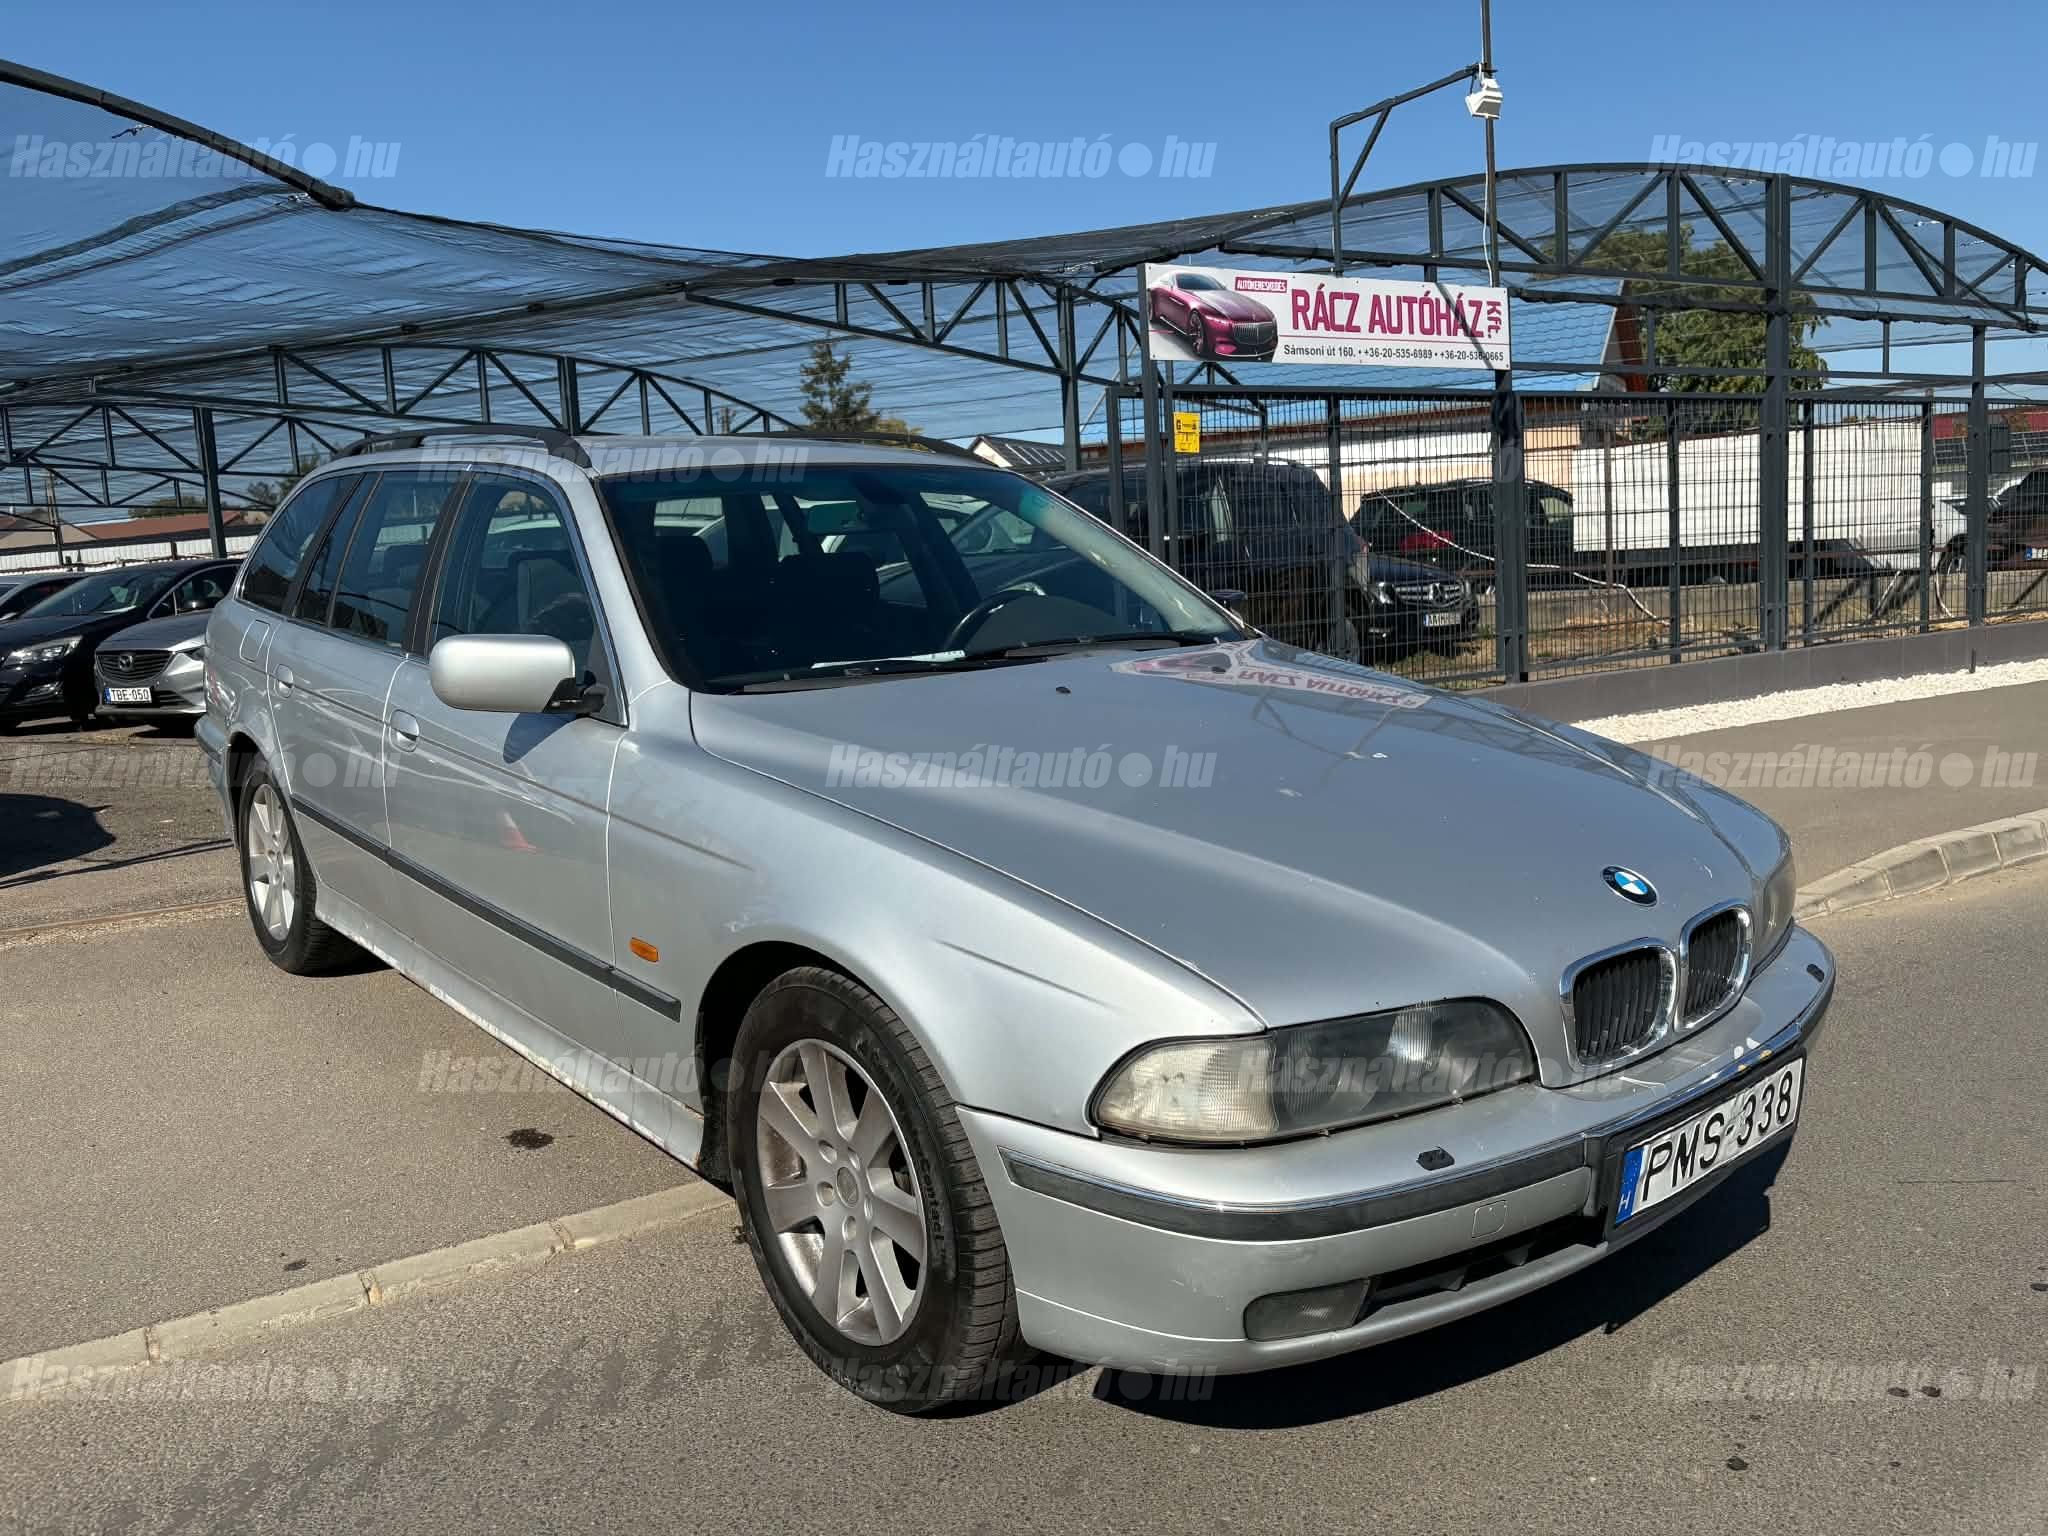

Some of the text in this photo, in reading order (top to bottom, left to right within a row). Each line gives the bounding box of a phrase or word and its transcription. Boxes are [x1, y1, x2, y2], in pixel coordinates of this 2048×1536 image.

[1291, 283, 1484, 338] RÁCZ AUTÓHÁZ
[1486, 301, 1503, 339] Kft.
[1284, 344, 1325, 357] Sámsoni
[1326, 345, 1336, 357] út
[1338, 346, 1356, 357] 160.
[1617, 1070, 1793, 1213] H PMS-338
